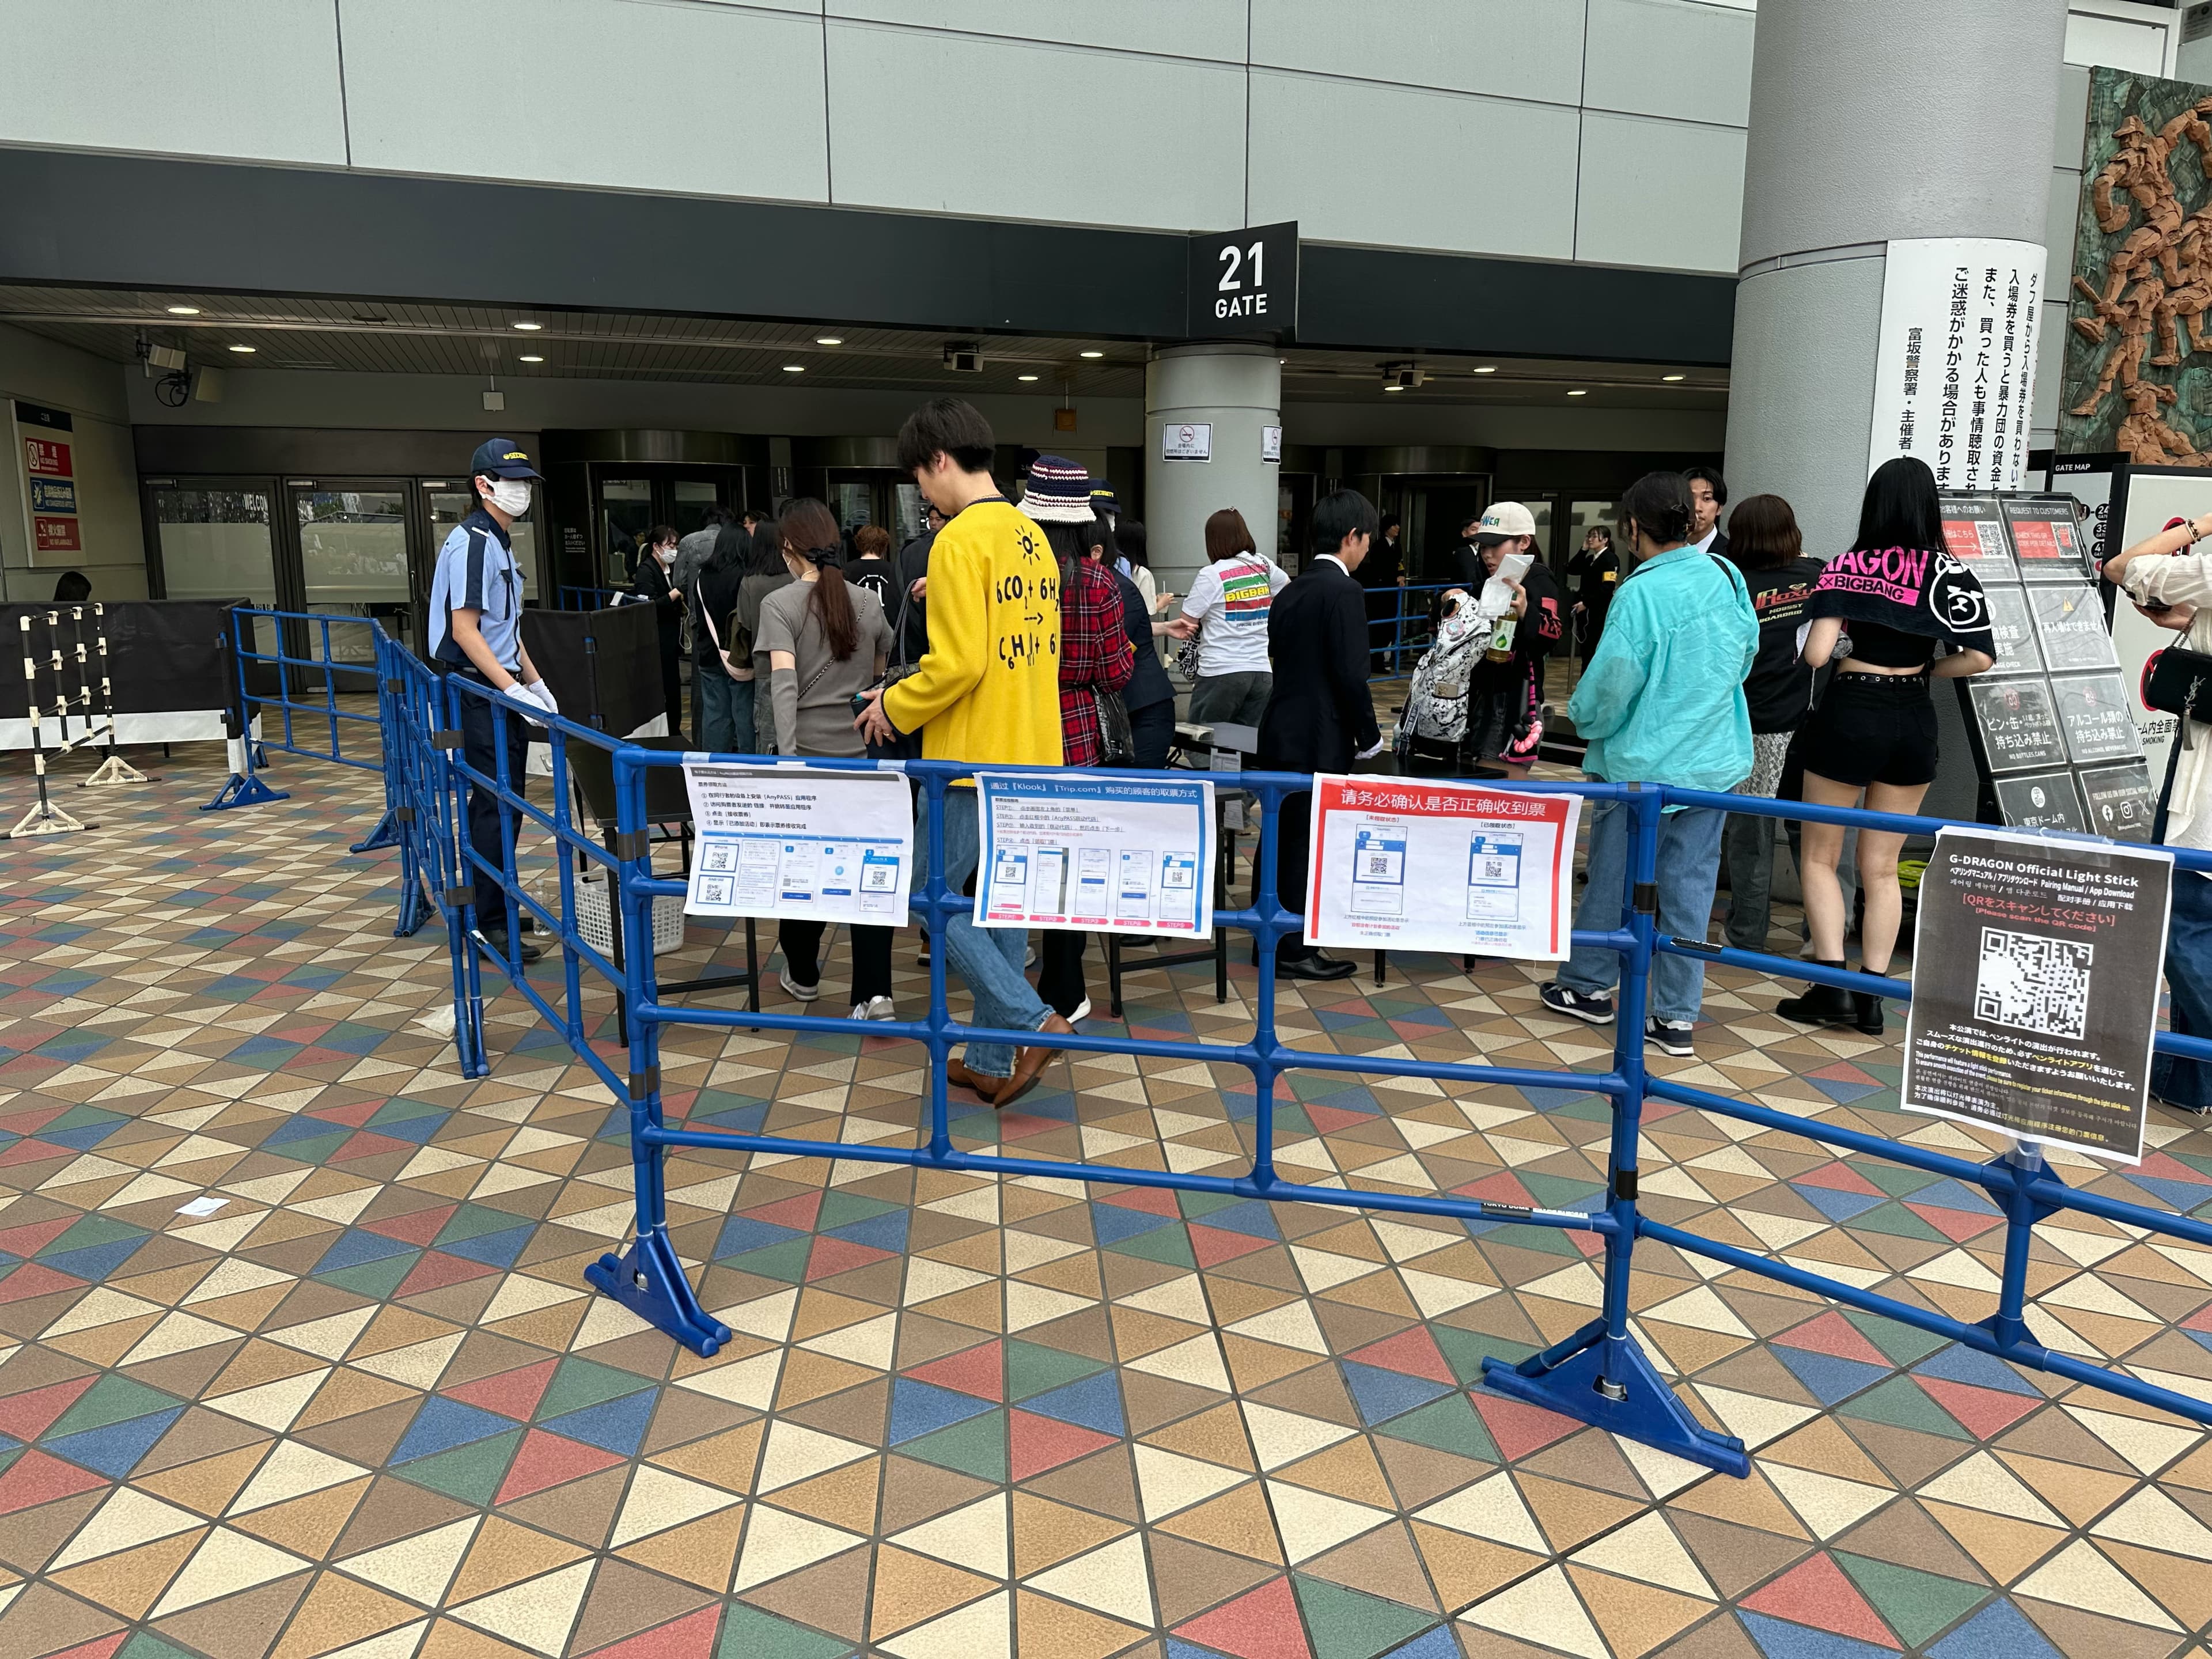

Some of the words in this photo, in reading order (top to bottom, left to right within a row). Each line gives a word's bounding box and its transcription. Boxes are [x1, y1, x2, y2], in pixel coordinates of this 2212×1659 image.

[1219, 241, 1263, 291] 21
[1215, 293, 1267, 319] GATE
[2043, 622, 2103, 633] 再入場はできません
[2067, 710, 2123, 727] アルコール類の
[1995, 732, 2052, 750] 持ち込み禁止
[2075, 726, 2125, 744] 持ち込み禁止
[2142, 736, 2165, 745] SMOKING
[990, 782, 1008, 790] 通过
[1105, 786, 1198, 798] 购买的顾客的取票方式
[2092, 791, 2107, 801] FOLLOW
[1340, 789, 1546, 817] 请务必确认是否正确收到票
[2022, 812, 2065, 827] 東京ドーム内
[1949, 854, 2013, 870] G-DRAGON
[2017, 863, 2062, 878] Official
[2066, 870, 2101, 884] Light
[2104, 874, 2139, 887] Stick
[1950, 868, 1993, 880] ペアリングマニュアル
[1998, 874, 2038, 887] アプリダウンロード
[2041, 880, 2061, 891] Pairing
[2062, 883, 2084, 893] Manual
[2089, 887, 2103, 897] App
[2104, 888, 2134, 899] Download
[1963, 893, 2115, 926] [QRをスキャンしてください]
[2016, 888, 2048, 899] 다운로드
[2057, 893, 2090, 906] 配对手册
[2098, 898, 2133, 911] 应用下载
[1975, 907, 2007, 919] [Please
[2009, 913, 2032, 922] scan
[2034, 916, 2050, 925] the
[2052, 919, 2066, 927] QR
[2068, 922, 2096, 932] code]
[1926, 1029, 2125, 1078] スムーズな演出進行のため、必ずペンライトアプリを通じて
[1949, 1024, 2101, 1061] 本公演では、ペンライトの演出が行われます。
[1916, 1038, 2135, 1091] ご自身のチケット情報を登録いただきますようお願いいたします。
